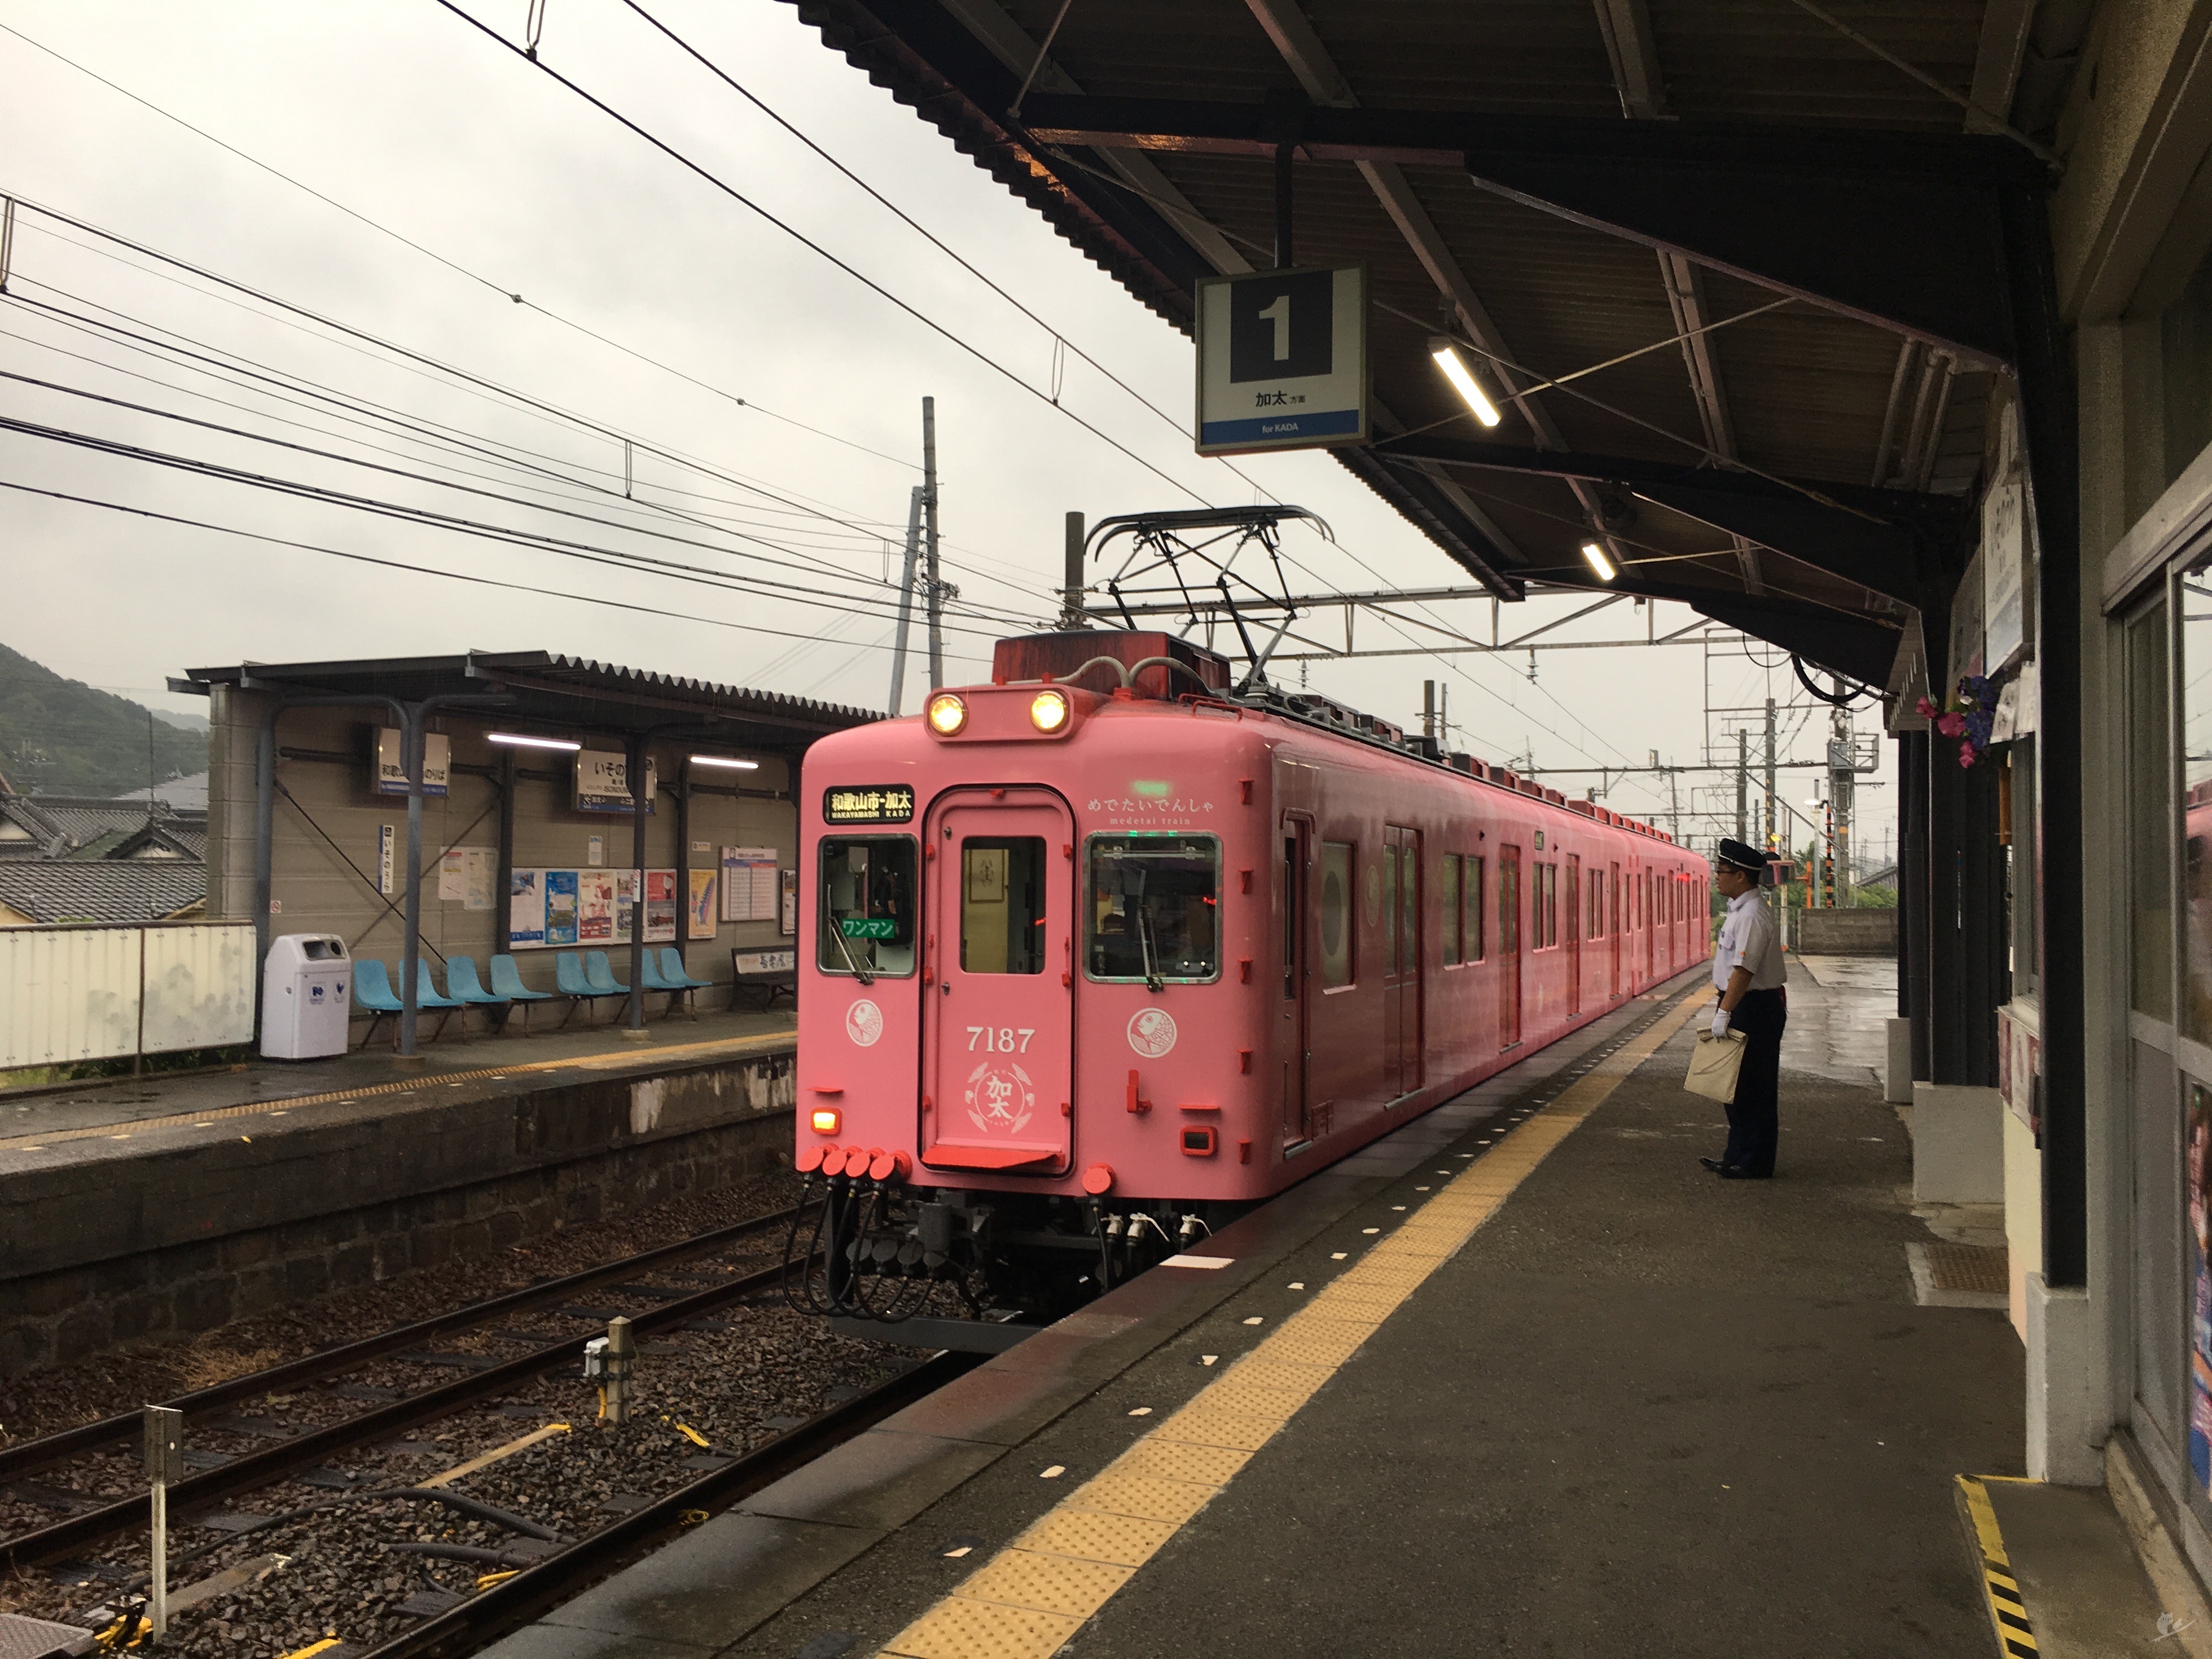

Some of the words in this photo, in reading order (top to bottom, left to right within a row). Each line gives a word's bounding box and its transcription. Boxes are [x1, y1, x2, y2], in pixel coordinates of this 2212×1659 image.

[1259, 295, 1289, 361] 1
[1262, 425, 1272, 433] for
[1274, 423, 1299, 432] KADA
[595, 762, 625, 777] いその
[1088, 798, 1214, 812] めでたいでんしゃ
[832, 810, 879, 819] WAKAYAMASHI
[843, 921, 893, 936] ワンマン
[967, 1026, 1035, 1053] 7187
[985, 1075, 1013, 1119] 加太
